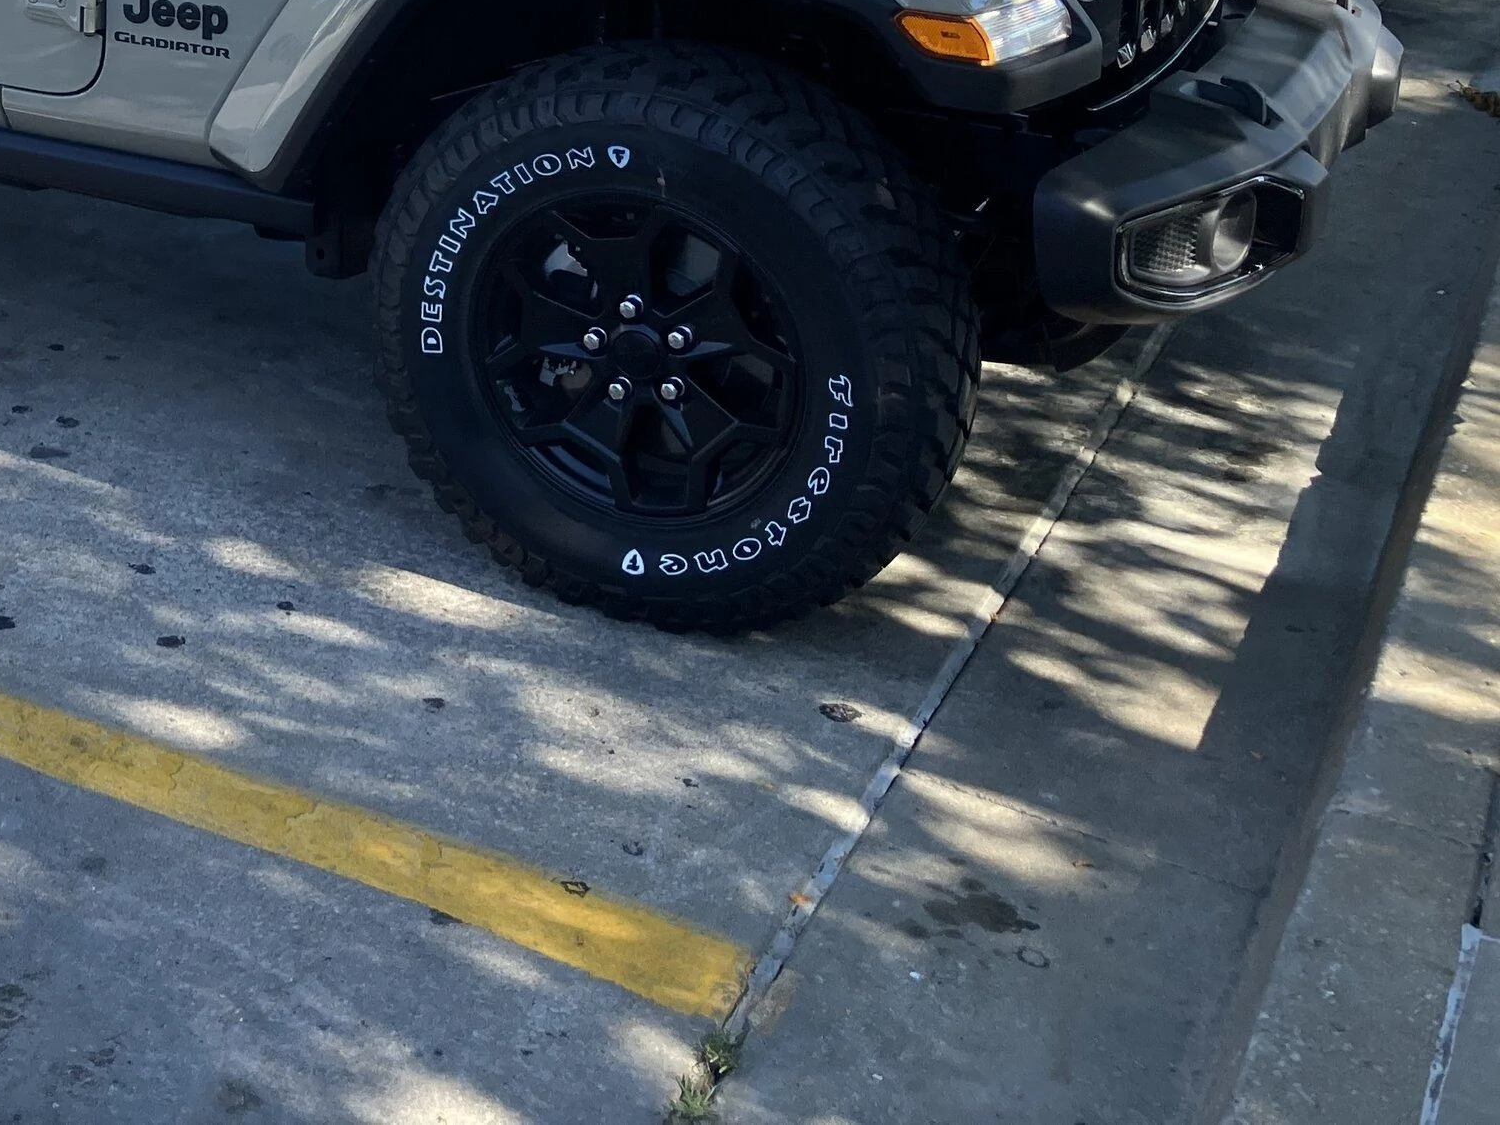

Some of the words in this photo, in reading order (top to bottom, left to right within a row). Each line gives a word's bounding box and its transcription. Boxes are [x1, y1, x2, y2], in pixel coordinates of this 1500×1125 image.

[114, 30, 231, 60] GLADIATOR
[420, 146, 596, 354] DESTINATION
[658, 374, 853, 575] Firestone
